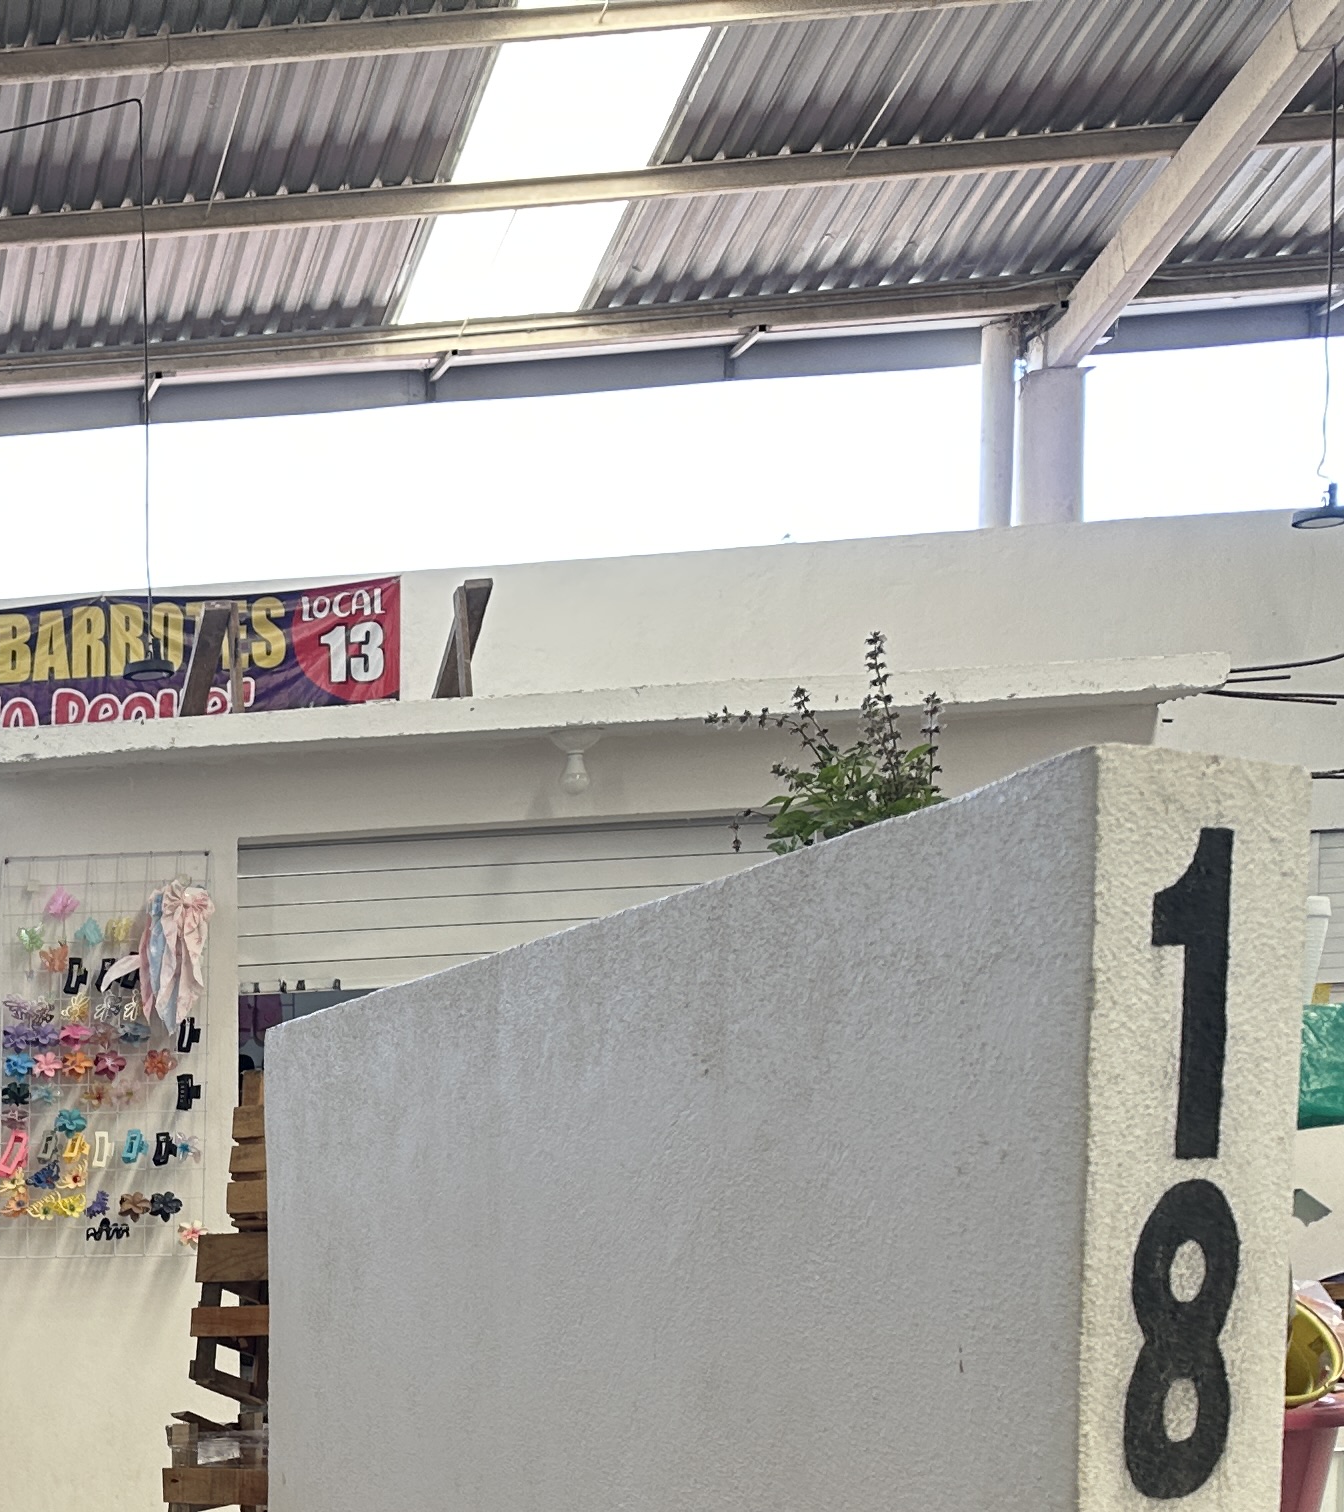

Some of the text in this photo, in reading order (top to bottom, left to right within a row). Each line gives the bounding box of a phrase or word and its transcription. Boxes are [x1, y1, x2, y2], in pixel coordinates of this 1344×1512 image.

[301, 588, 387, 623] LOCAL
[319, 620, 386, 684] 13
[1123, 827, 1240, 1500] 18
